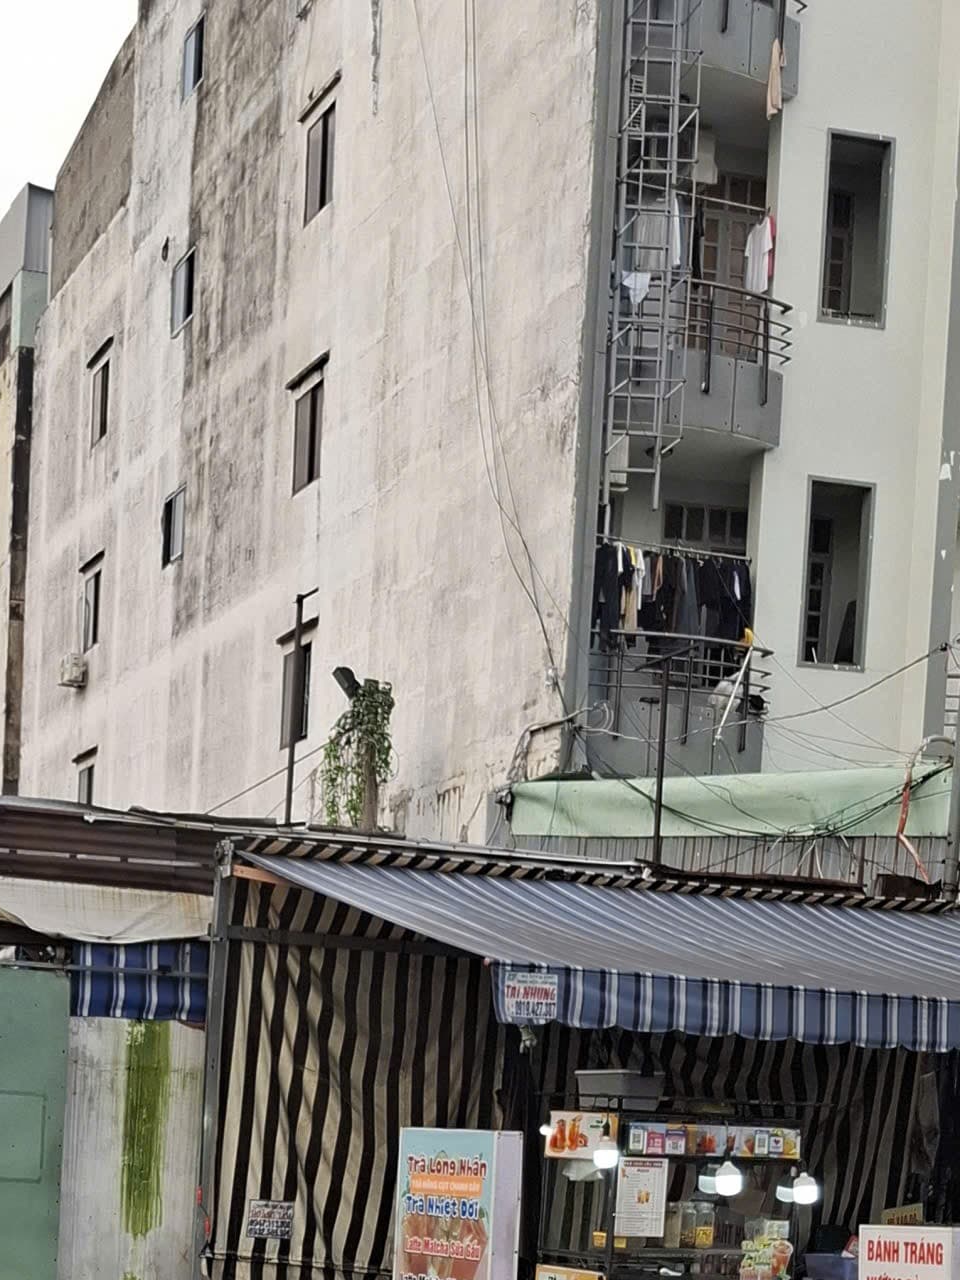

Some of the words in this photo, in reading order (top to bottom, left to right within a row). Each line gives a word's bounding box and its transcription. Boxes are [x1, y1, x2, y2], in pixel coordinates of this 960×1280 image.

[408, 1154, 426, 1173] Trà
[429, 1158, 456, 1177] Long
[406, 1195, 424, 1213] Trà
[867, 1235, 900, 1263] BÁNH
[903, 1237, 944, 1266] TRÁNG
